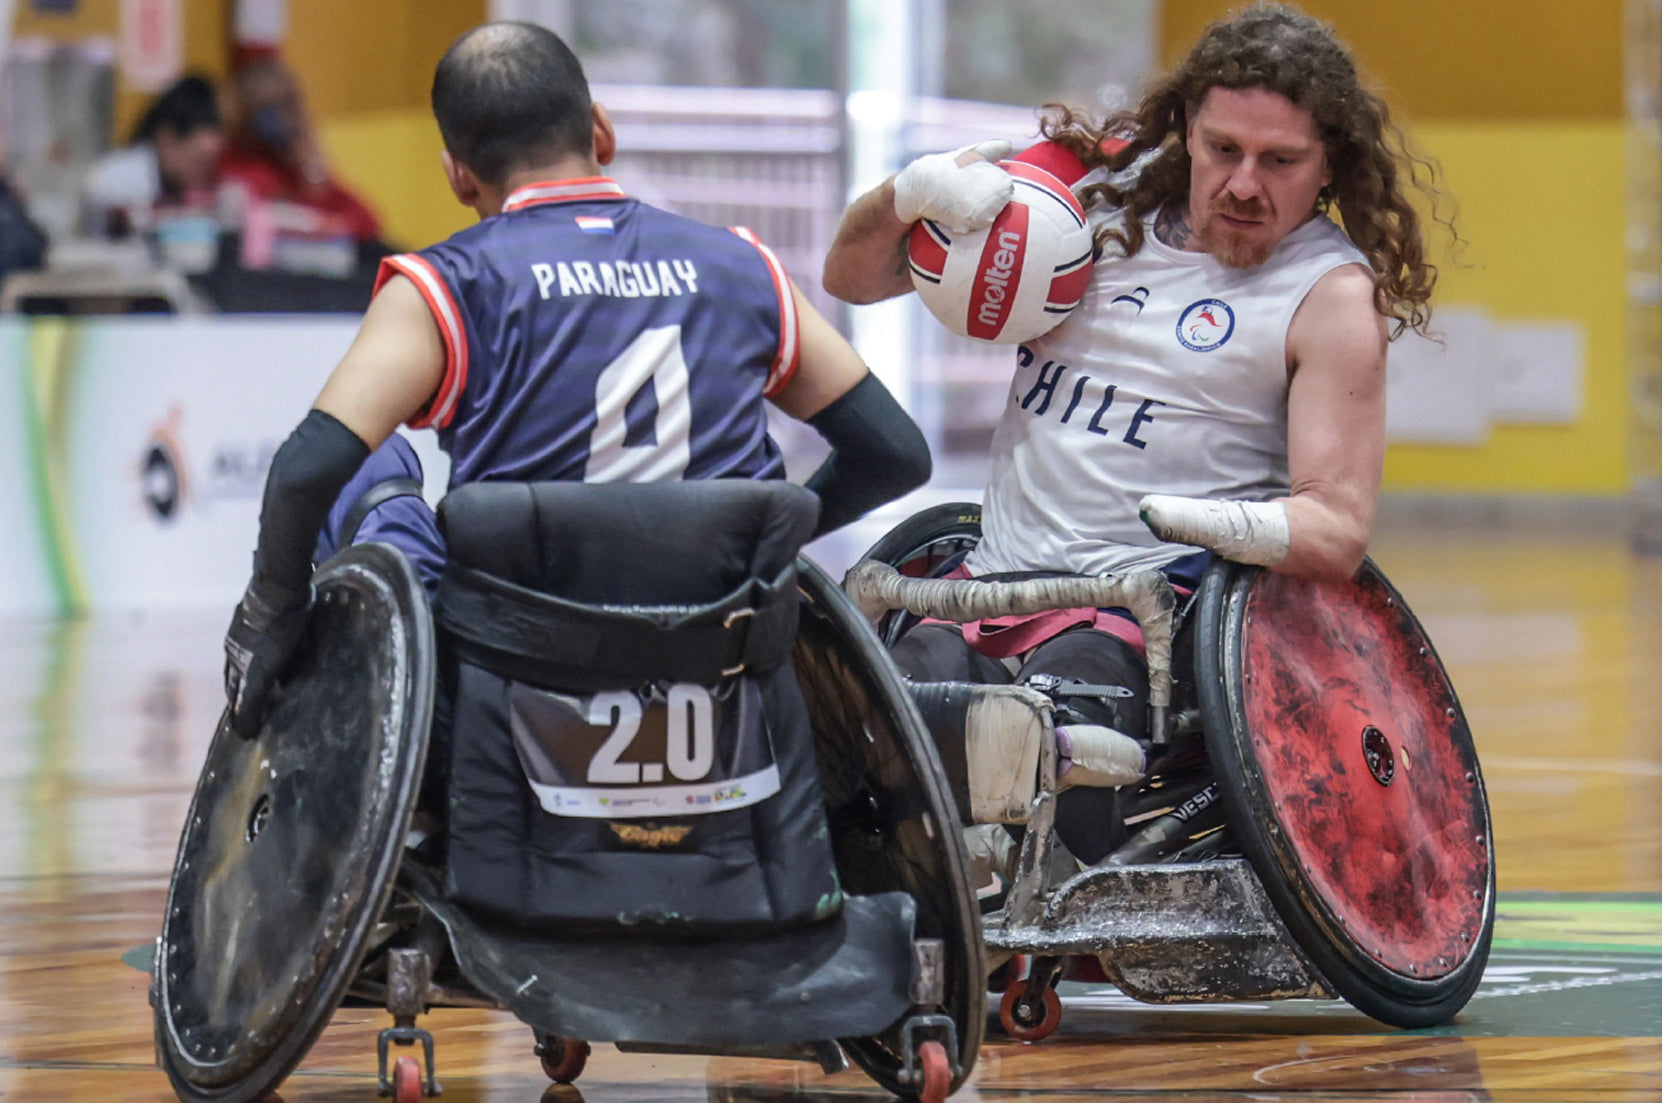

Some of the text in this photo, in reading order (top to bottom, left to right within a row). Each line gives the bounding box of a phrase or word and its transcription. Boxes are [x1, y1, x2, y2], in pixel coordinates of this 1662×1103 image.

[531, 259, 698, 300] PARAGUAY
[978, 231, 1020, 325] molten
[587, 684, 713, 783] 2.0
[1170, 782, 1219, 821] VESC
